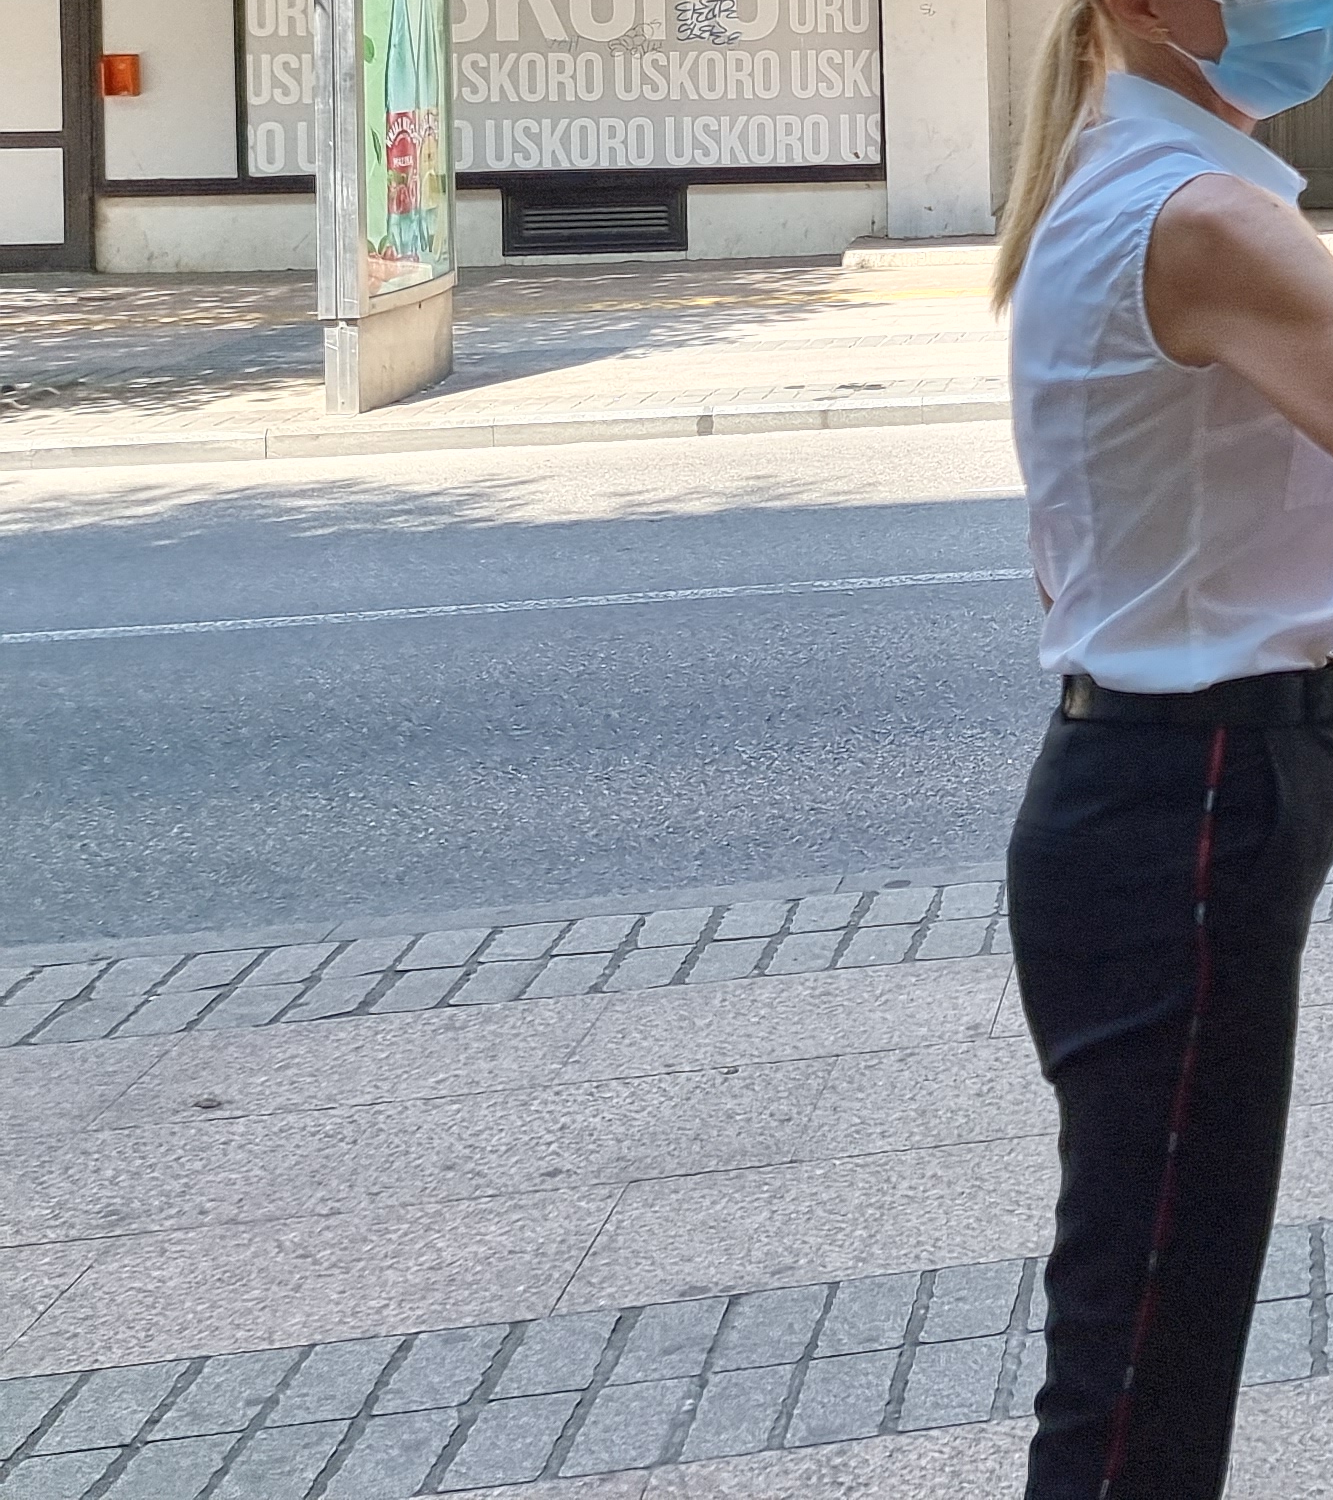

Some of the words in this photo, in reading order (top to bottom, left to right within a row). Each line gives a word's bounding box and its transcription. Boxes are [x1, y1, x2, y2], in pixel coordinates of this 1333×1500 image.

[453, 51, 604, 104] SKORO
[614, 49, 781, 100] USKORO
[790, 49, 880, 99] USK
[485, 115, 654, 170] USKORO
[665, 113, 830, 166] USKORO
